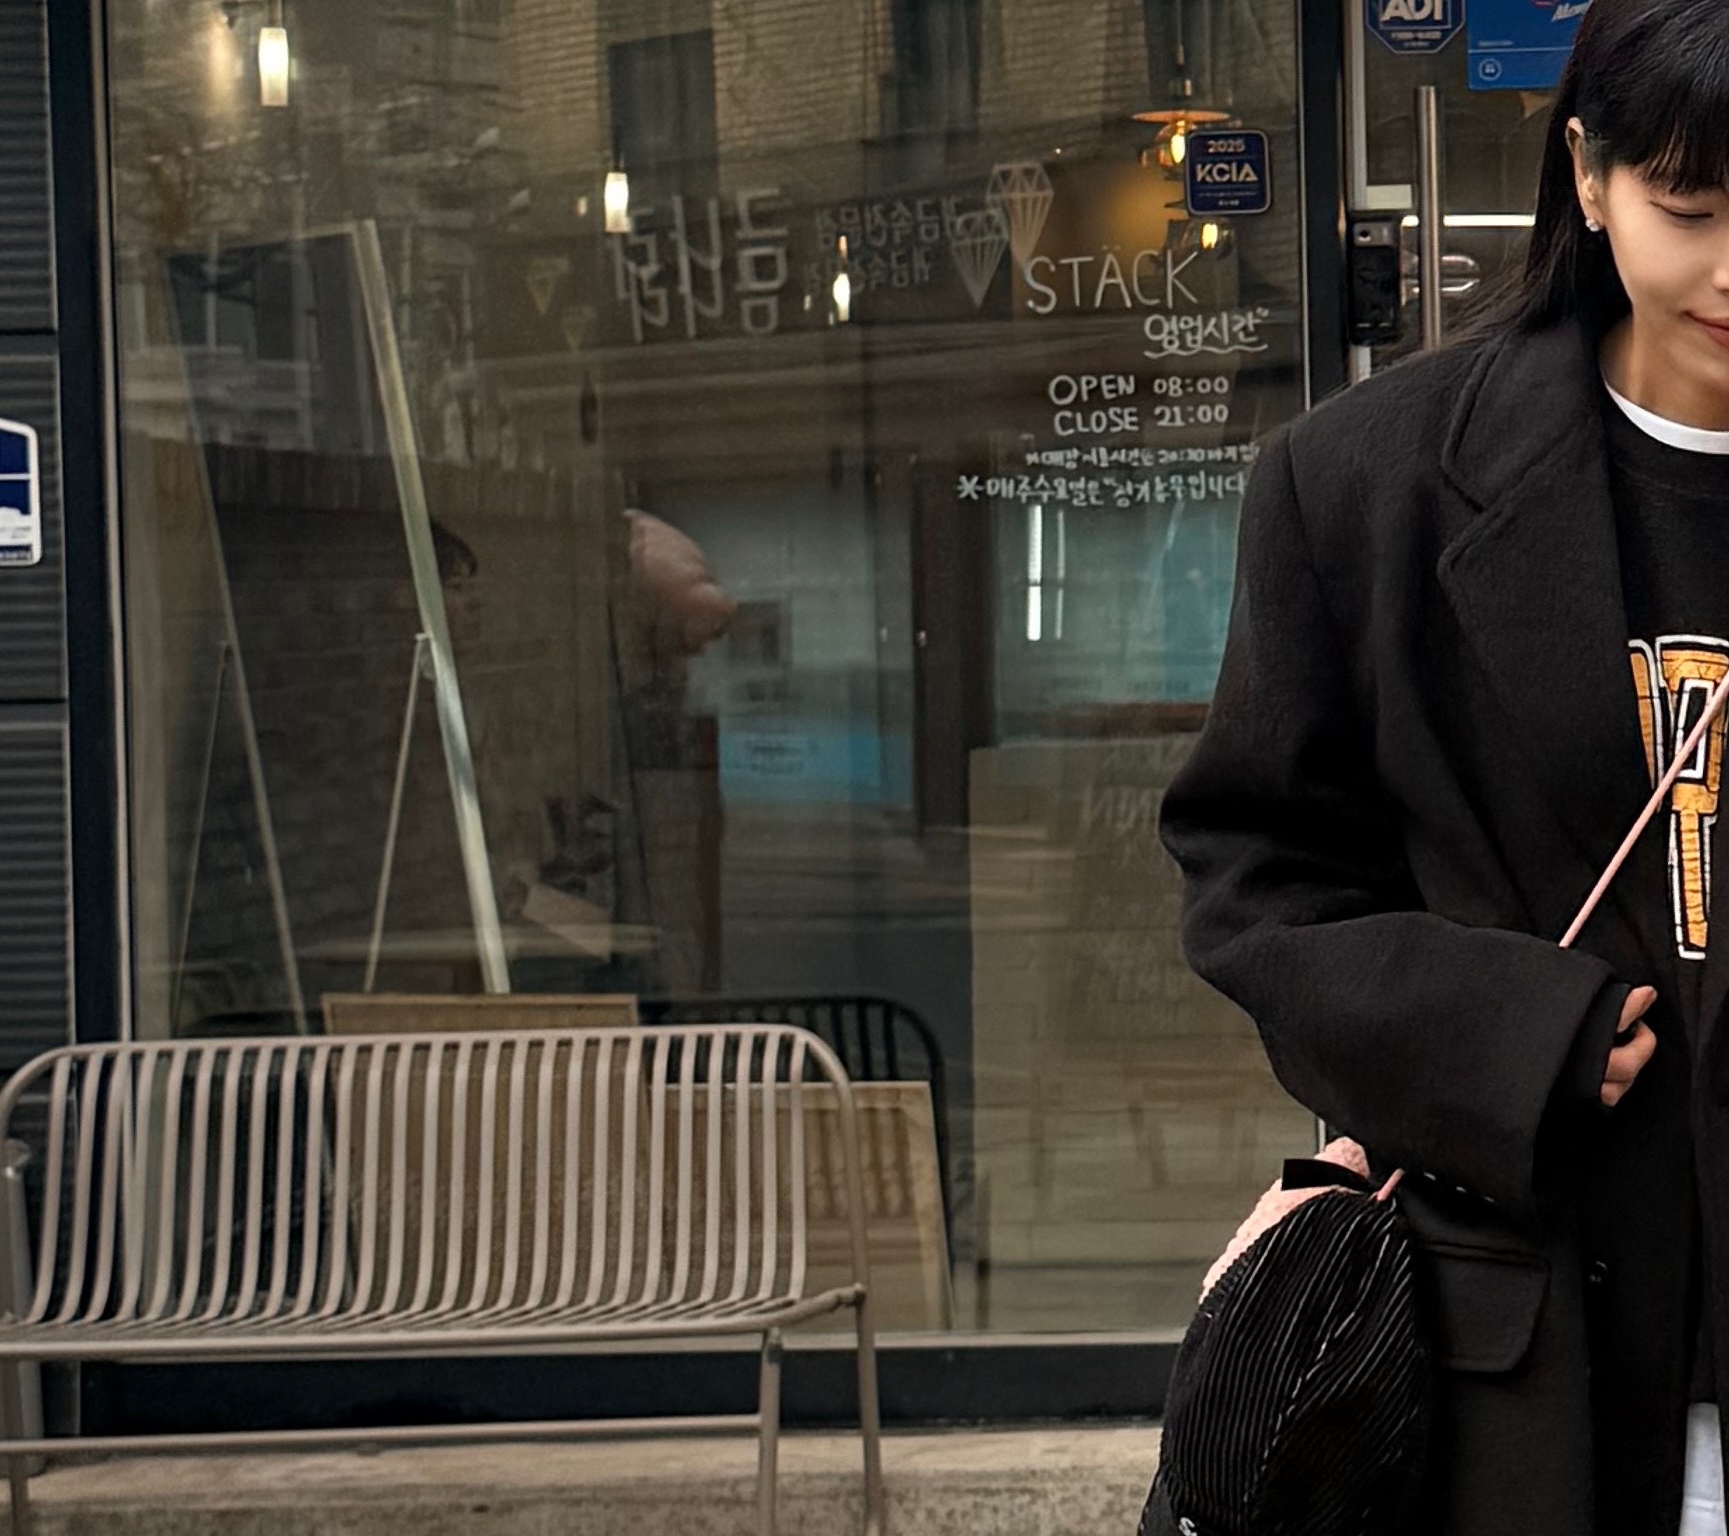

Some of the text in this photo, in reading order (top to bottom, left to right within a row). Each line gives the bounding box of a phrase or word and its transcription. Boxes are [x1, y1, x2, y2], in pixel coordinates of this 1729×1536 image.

[1207, 138, 1246, 154] 2025
[1195, 161, 1259, 184] KCIA
[1048, 374, 1230, 406] OPEN 08:00
[1053, 403, 1230, 437] CLOSE 21:00
